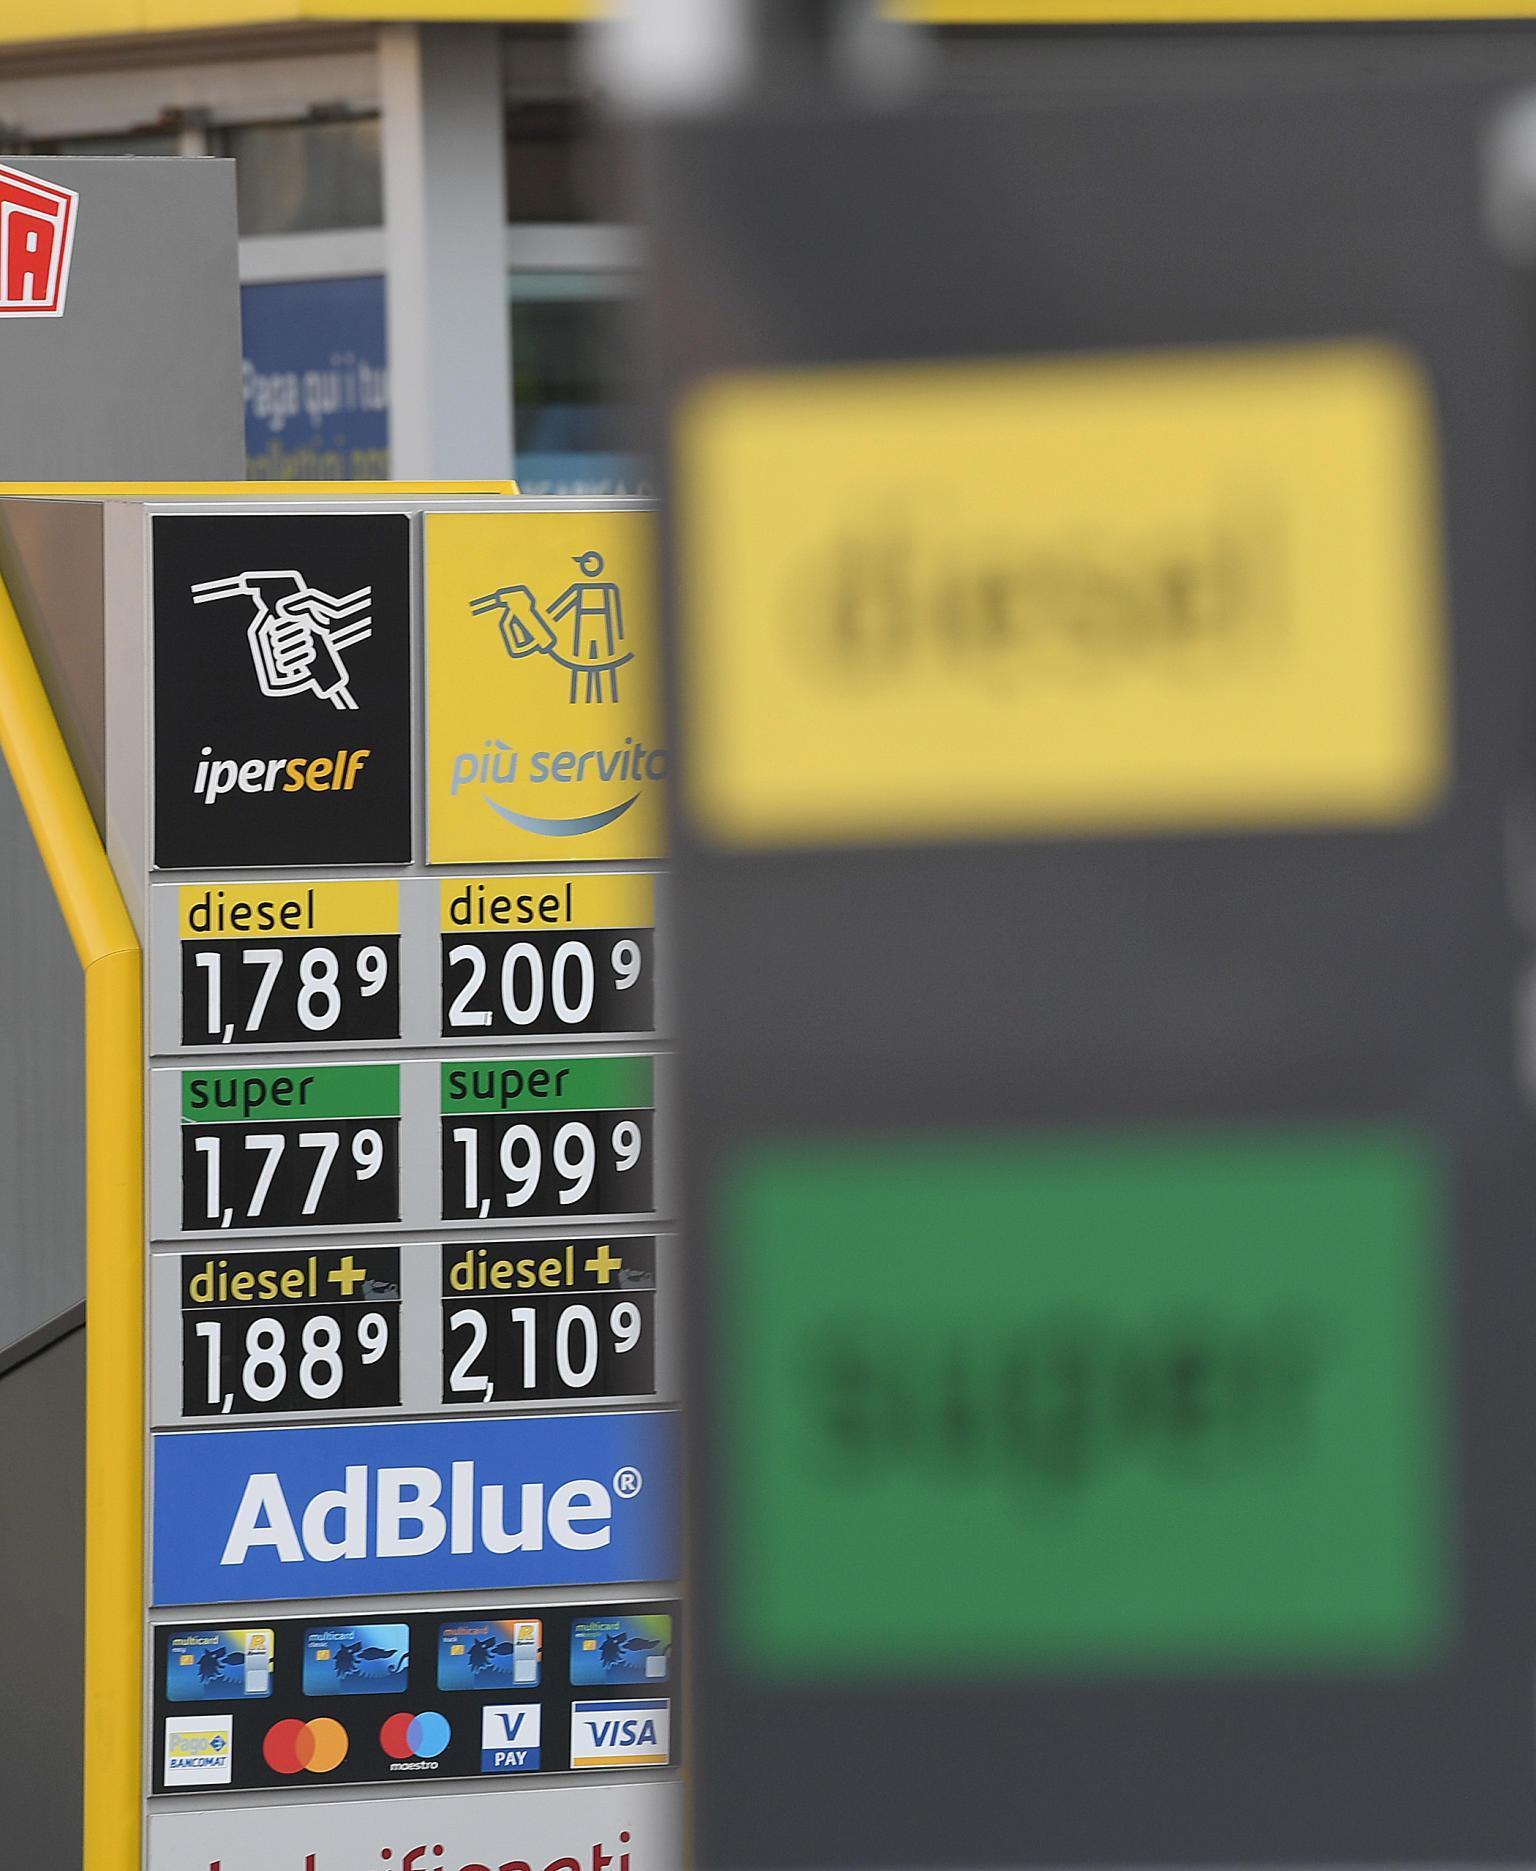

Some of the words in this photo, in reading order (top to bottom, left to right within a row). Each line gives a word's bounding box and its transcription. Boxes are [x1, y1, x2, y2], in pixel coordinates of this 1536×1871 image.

[194, 746, 370, 805] iperself
[450, 739, 519, 796] più
[190, 889, 314, 933] diesel
[450, 882, 572, 926] diesel
[190, 1076, 314, 1118] super
[449, 1067, 571, 1109] super
[172, 1635, 219, 1646] multicard
[308, 1631, 355, 1642] multicard
[575, 1621, 620, 1632] multicard
[494, 1713, 525, 1742] V
[584, 1719, 658, 1748] VISA
[170, 1757, 226, 1769] BANCOMAT
[389, 1761, 439, 1771] maestro
[494, 1750, 528, 1767] PAY
